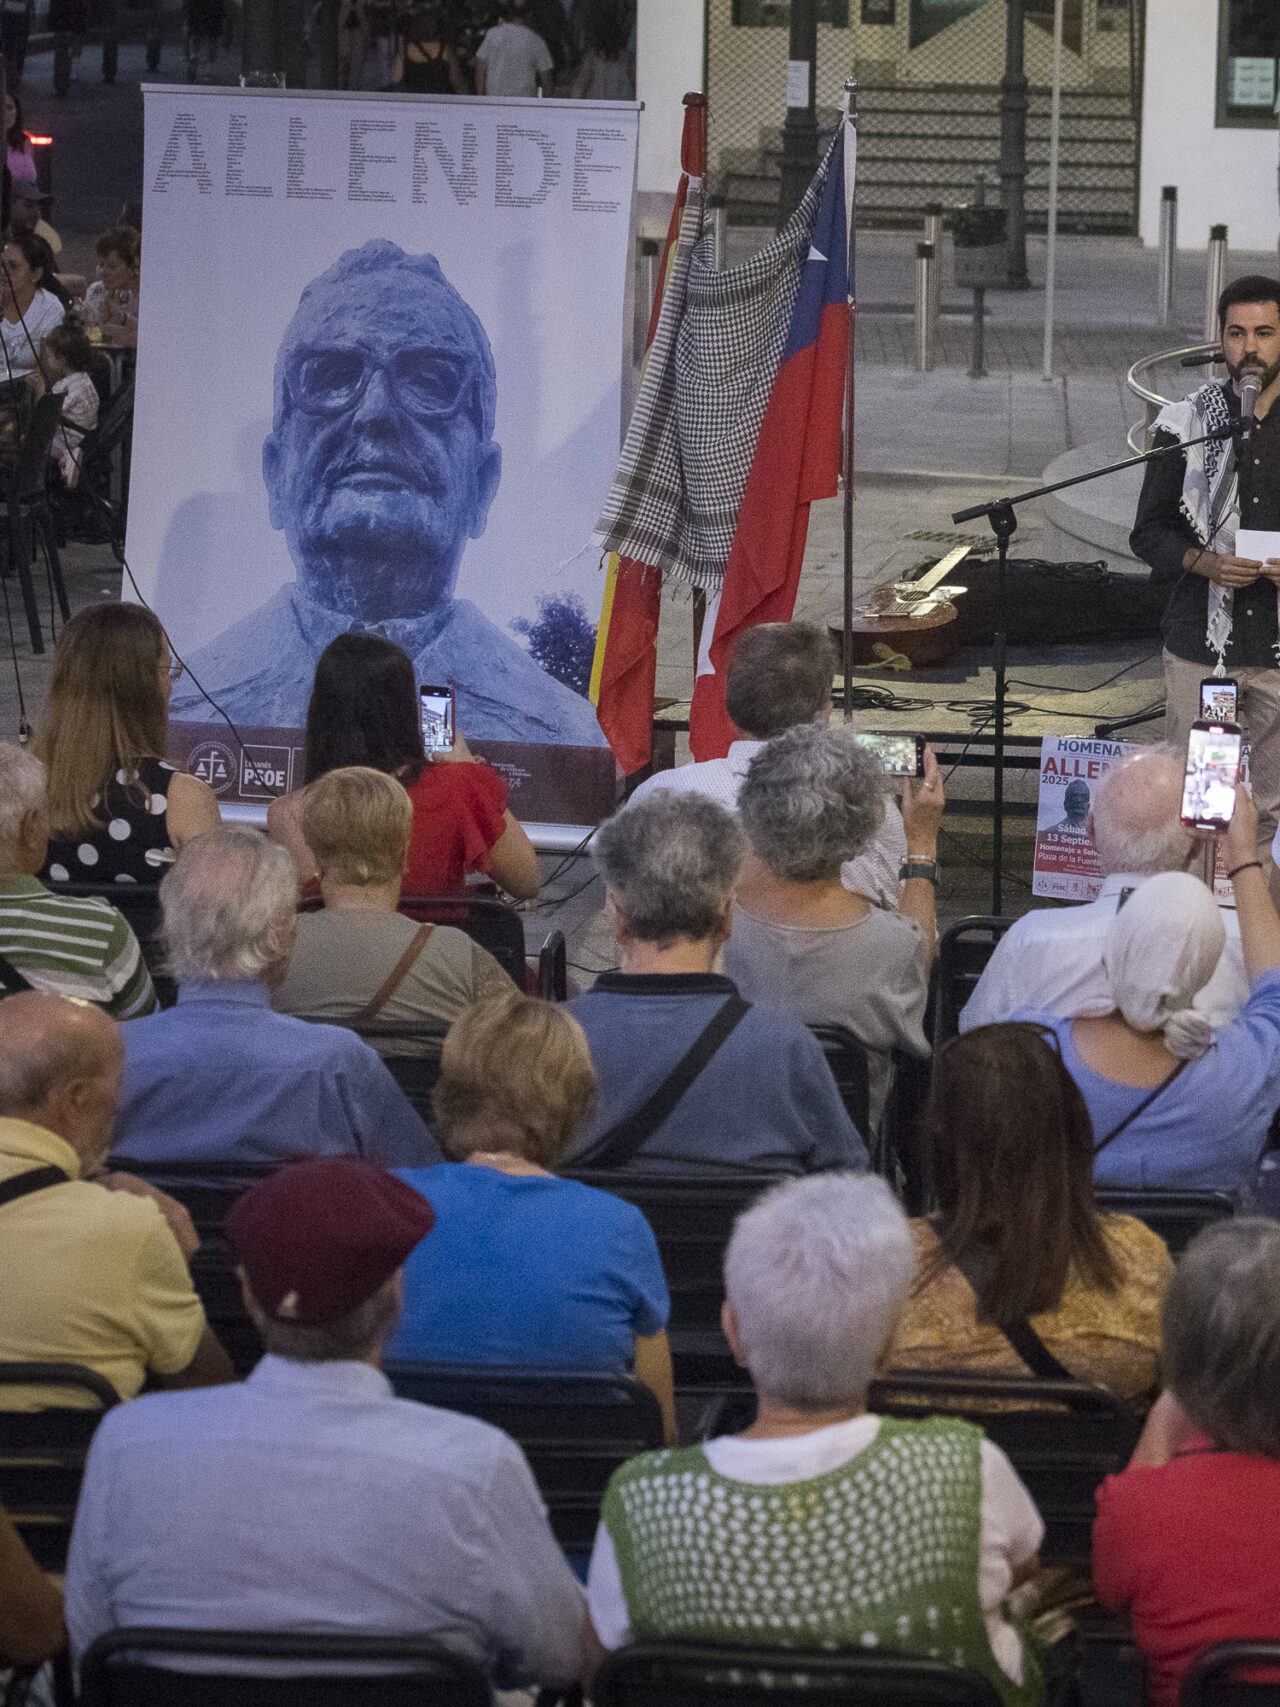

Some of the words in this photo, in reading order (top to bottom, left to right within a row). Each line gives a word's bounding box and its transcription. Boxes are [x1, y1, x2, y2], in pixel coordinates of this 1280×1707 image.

[152, 113, 627, 212] ALLENDE
[1057, 740, 1125, 757] HOMENA
[244, 768, 286, 787] PSOE
[1041, 775, 1070, 786] 2025
[1047, 833, 1059, 842] 13
[1060, 834, 1093, 847] Septie
[1037, 852, 1057, 862] Plaza
[1040, 843, 1076, 855] Homenaje
[1083, 848, 1099, 857] Salv
